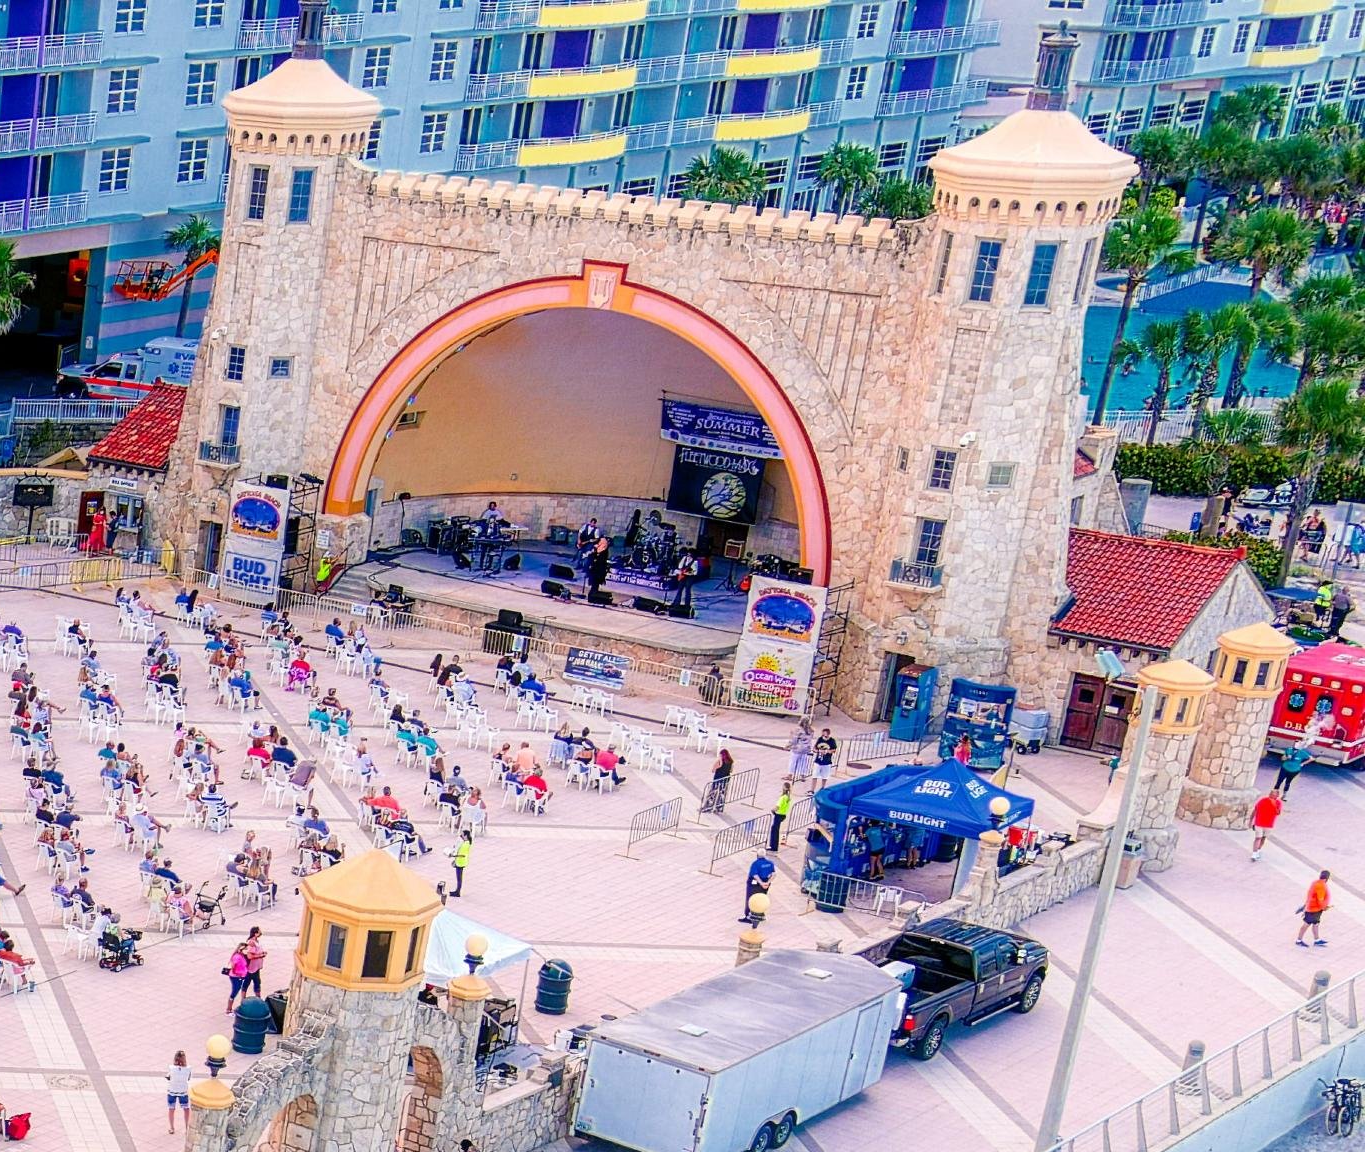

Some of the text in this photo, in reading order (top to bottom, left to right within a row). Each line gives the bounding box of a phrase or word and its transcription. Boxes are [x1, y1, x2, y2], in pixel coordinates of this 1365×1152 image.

[174, 352, 196, 360] EVA
[694, 418, 761, 438] SUMMER
[226, 557, 272, 590] BUD LIGHT
[578, 650, 594, 659] GET
[744, 671, 774, 682] Ocean
[924, 779, 951, 789] BUD
[914, 785, 953, 798] LIGHT
[889, 810, 947, 828] BUD LIGHT
